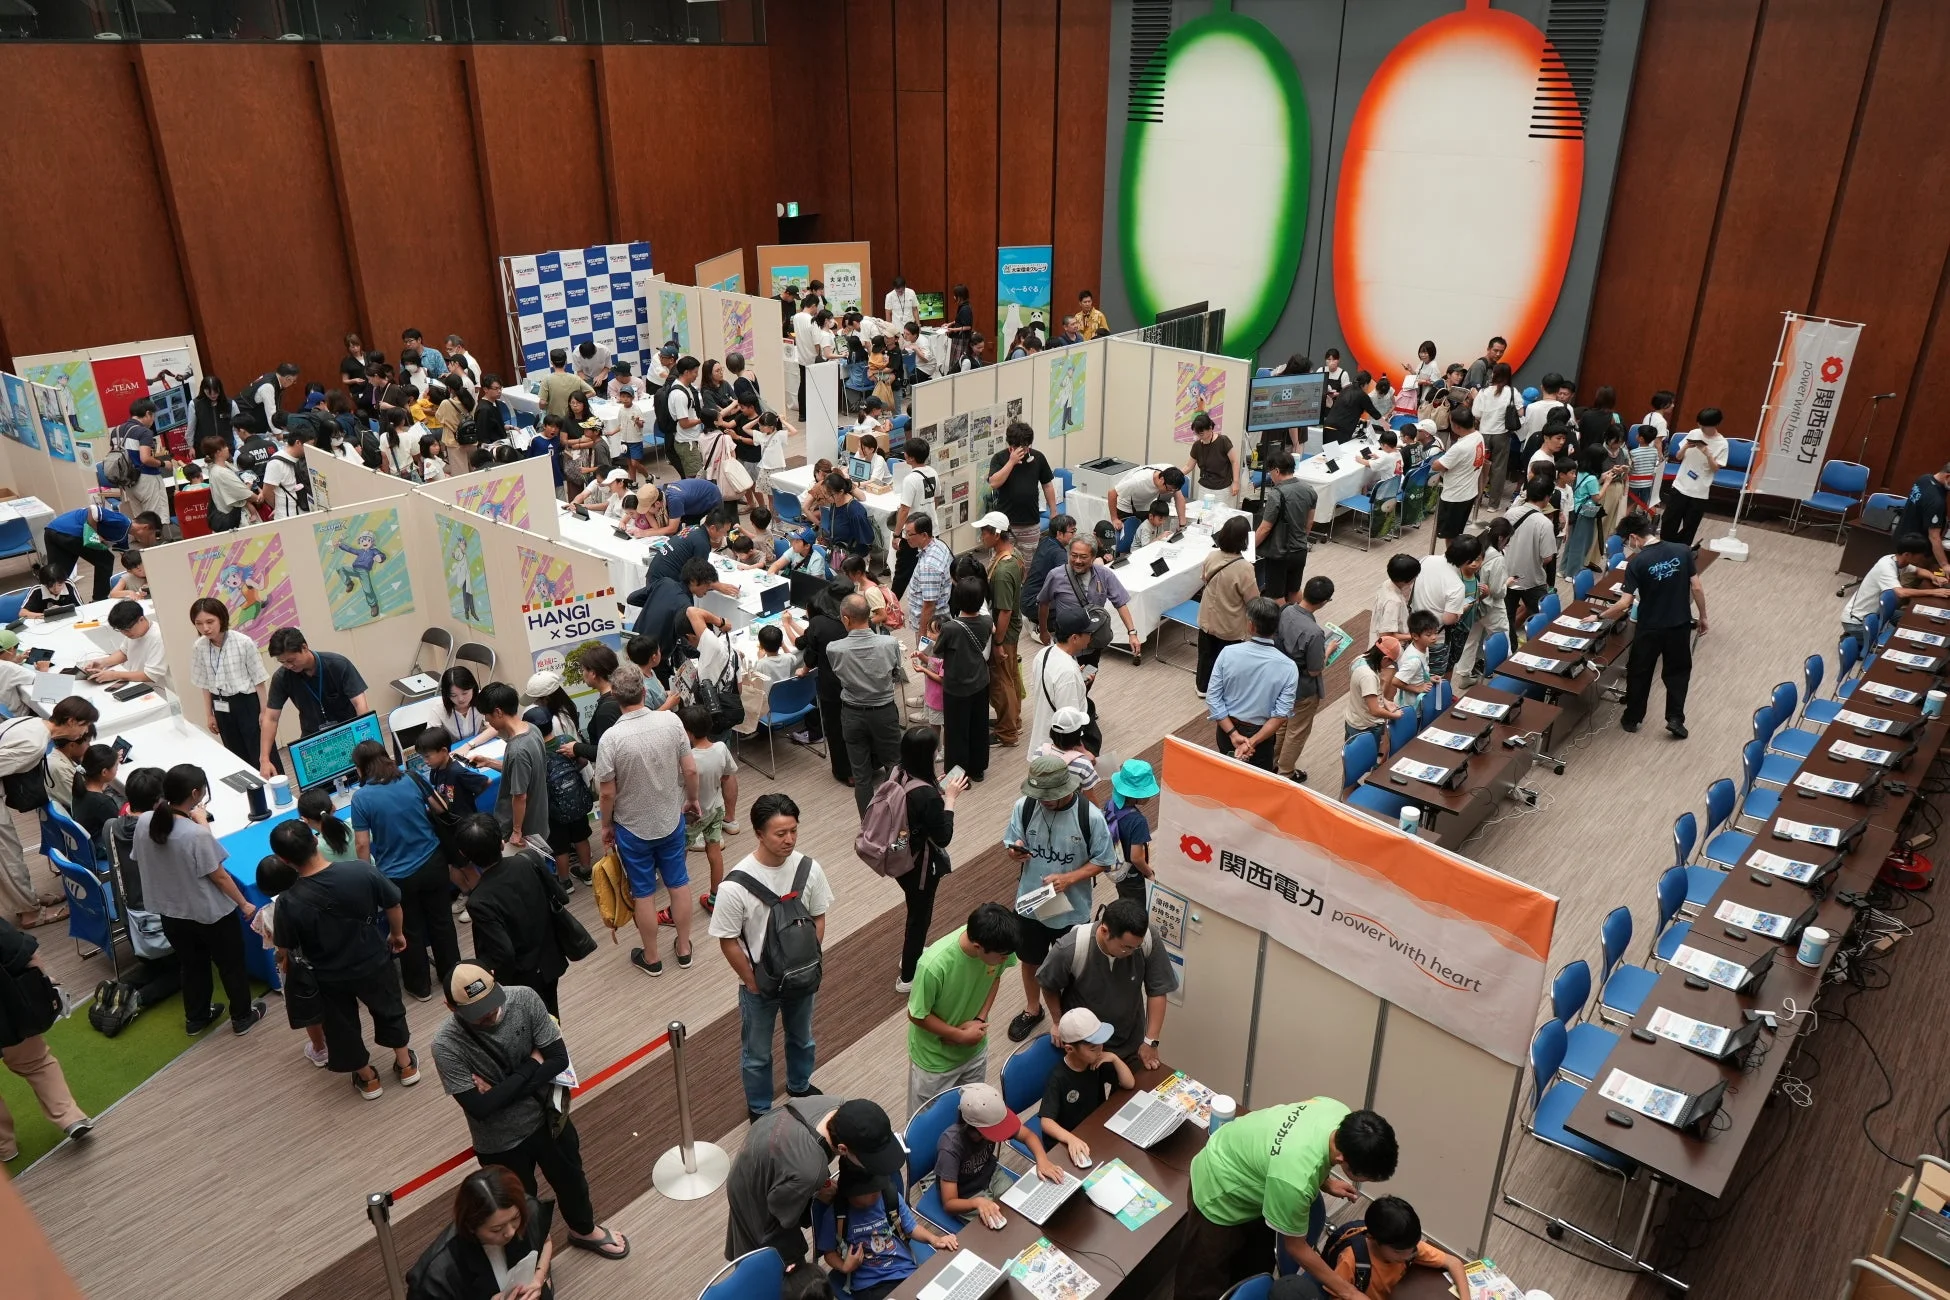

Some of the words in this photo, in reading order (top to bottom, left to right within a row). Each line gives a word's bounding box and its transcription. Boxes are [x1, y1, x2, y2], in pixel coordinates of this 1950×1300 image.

[1797, 361, 1814, 399] power
[1789, 399, 1804, 425] with
[1797, 388, 1835, 464] 関西電力
[1780, 424, 1799, 454] heart
[528, 604, 590, 630] HANGI
[565, 619, 615, 638] SDGs
[1219, 849, 1325, 917] 関西電力
[1331, 908, 1385, 942] power
[1389, 936, 1426, 966] with
[1431, 956, 1482, 993] heart
[1270, 1105, 1307, 1156] マイクラカップ
